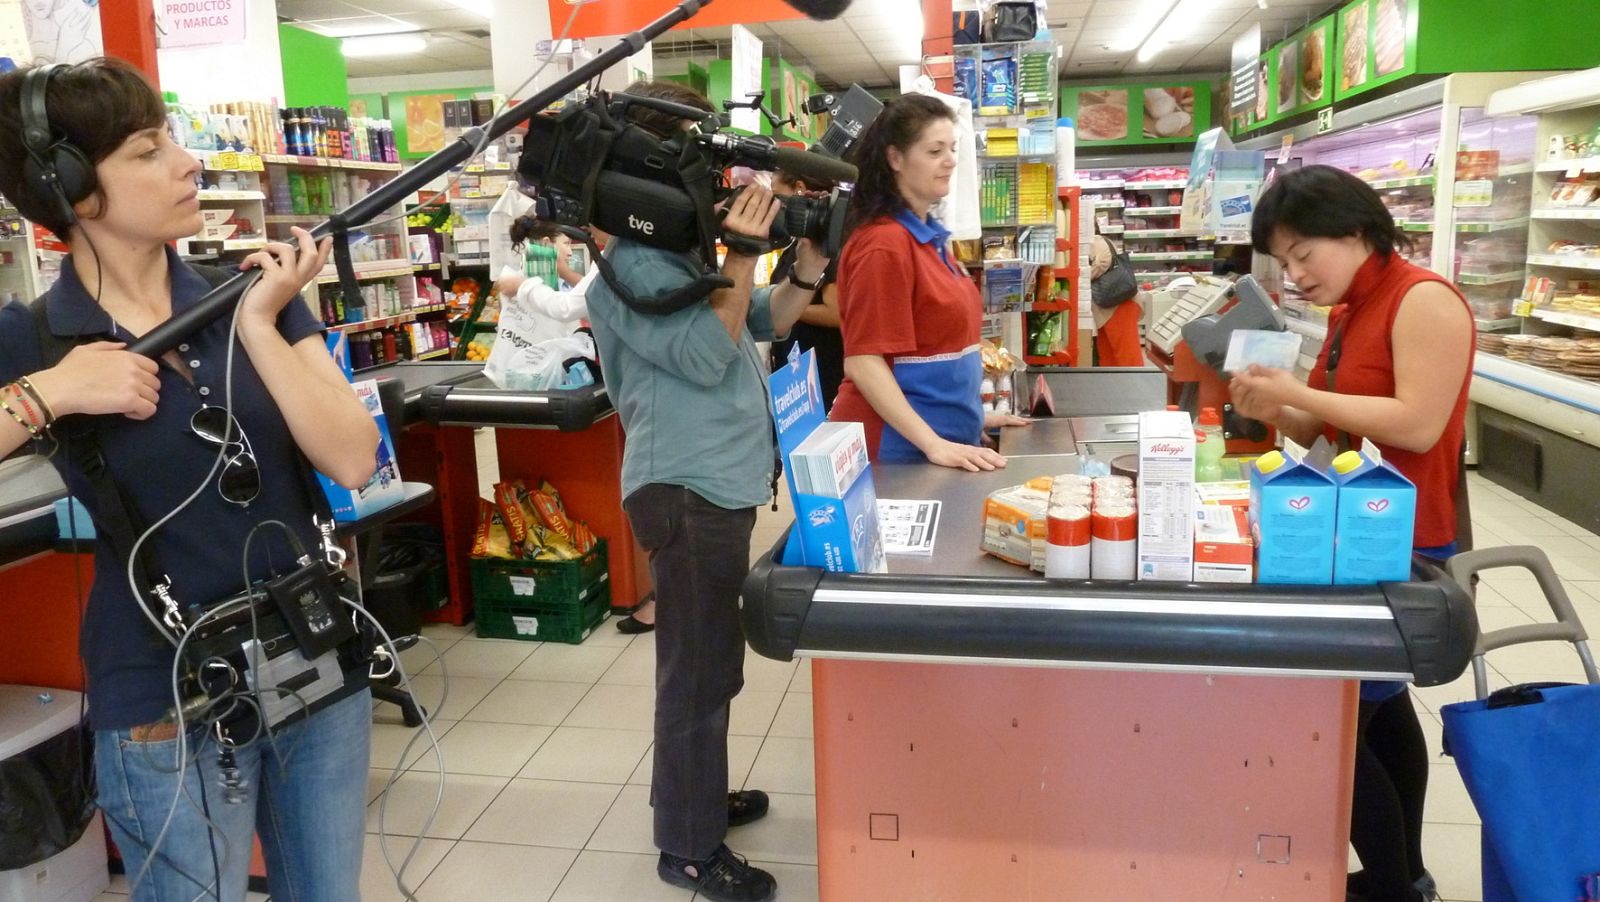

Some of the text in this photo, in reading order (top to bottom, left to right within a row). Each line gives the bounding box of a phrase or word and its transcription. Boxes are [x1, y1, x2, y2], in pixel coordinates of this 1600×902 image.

[166, 0, 232, 15] PRODUCTOS
[174, 15, 229, 30] Y MARCAS
[628, 214, 655, 235] tve
[1150, 443, 1184, 455] Kellogg's
